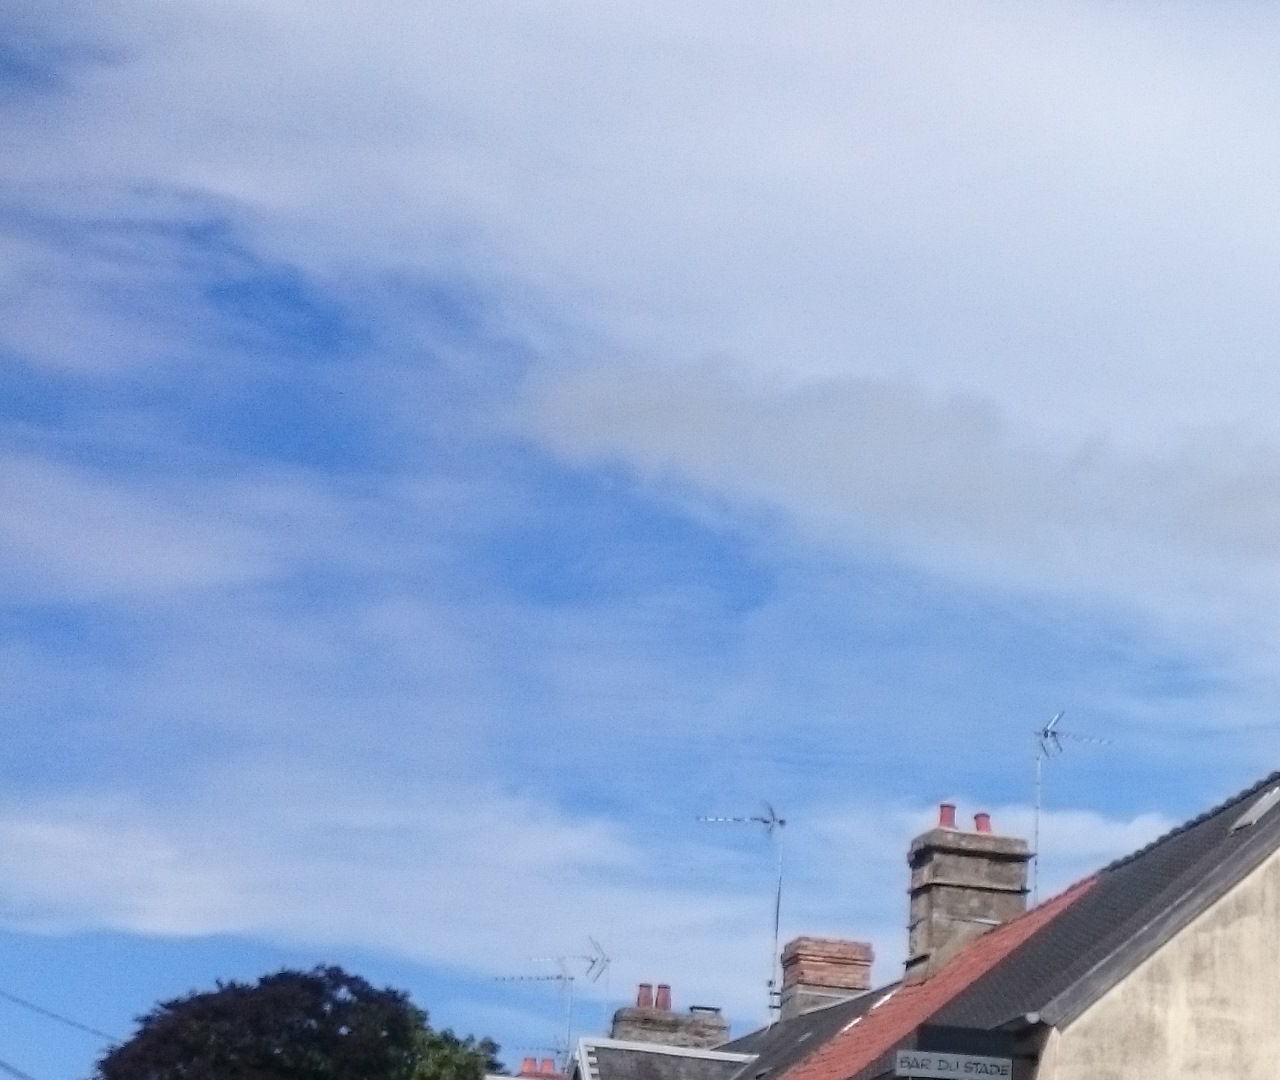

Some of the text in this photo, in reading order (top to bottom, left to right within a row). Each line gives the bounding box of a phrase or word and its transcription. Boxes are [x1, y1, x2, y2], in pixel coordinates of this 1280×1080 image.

[899, 1056, 1010, 1076] BAR DU STADE
